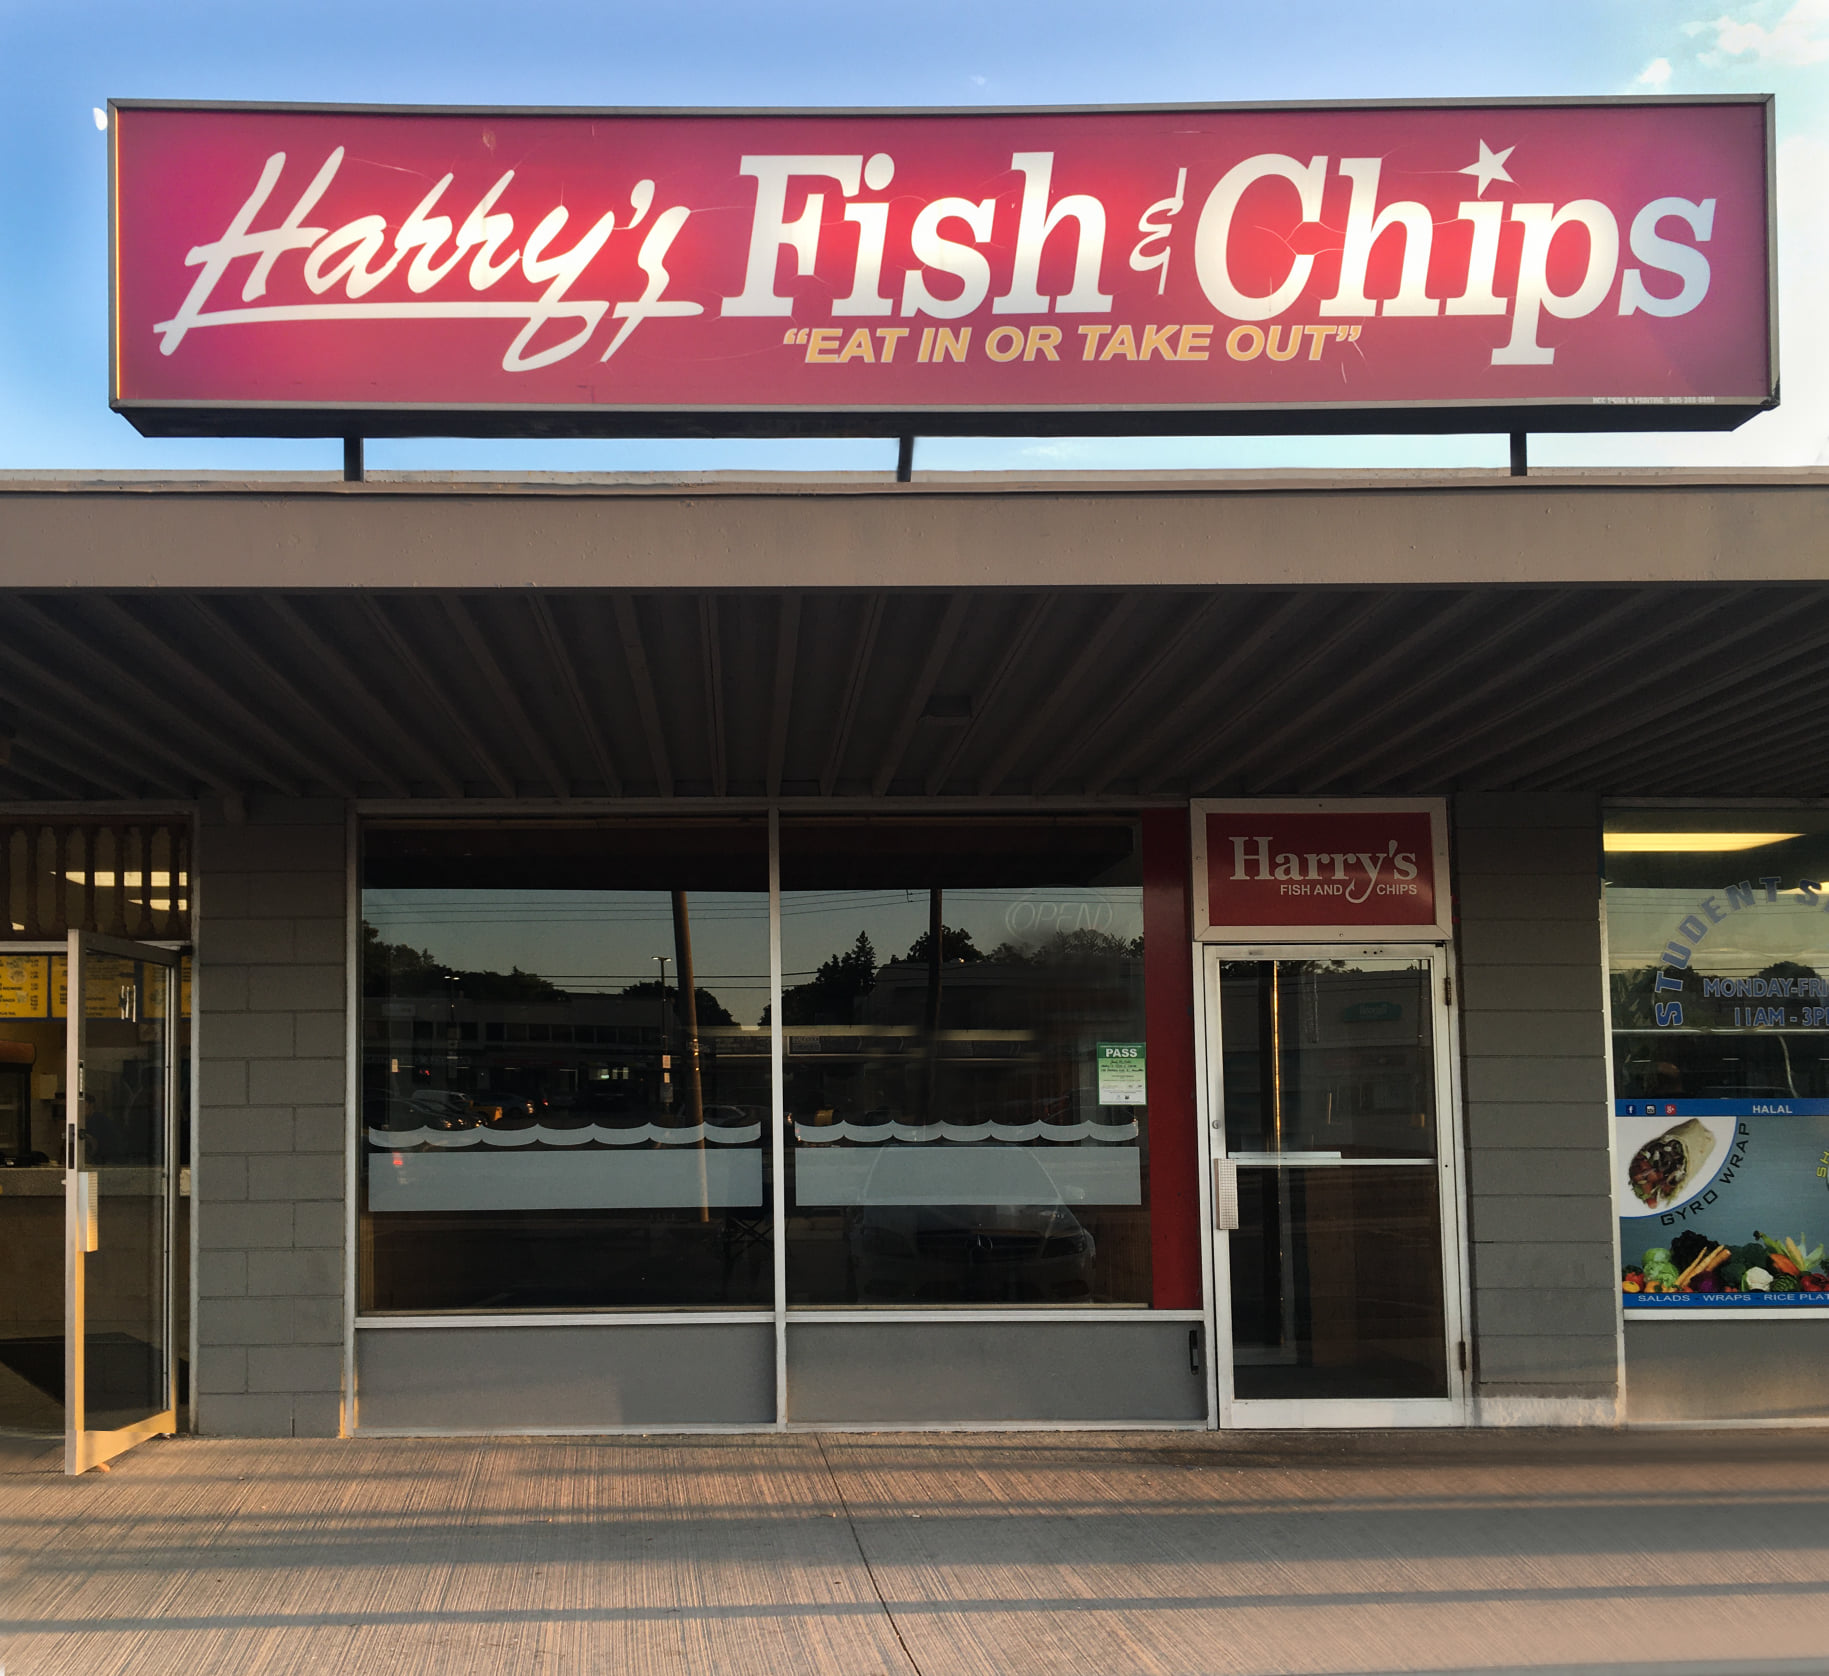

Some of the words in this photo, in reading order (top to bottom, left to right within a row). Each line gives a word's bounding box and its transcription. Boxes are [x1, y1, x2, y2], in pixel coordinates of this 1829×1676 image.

[153, 146, 705, 372] Harry's
[720, 152, 1114, 320] Fish
[1128, 166, 1188, 296] &
[1194, 138, 1717, 365] Chips
[917, 326, 977, 363] IN
[984, 325, 1064, 363] OR
[1076, 324, 1213, 362] TAKE
[1228, 836, 1418, 904] Harry's
[1280, 884, 1311, 896] FISH
[1313, 884, 1343, 896] AND
[1376, 884, 1418, 895] CHIPS
[1012, 901, 1104, 931] OPEN
[1105, 1048, 1138, 1058] PASS
[1752, 1104, 1793, 1115] HALAL
[1660, 1189, 1719, 1227] GYRO
[1718, 1122, 1751, 1184] WRAP
[1637, 1294, 1691, 1302] SALADS
[1702, 1294, 1752, 1302] WRAPS
[1763, 1293, 1795, 1301] RICE
